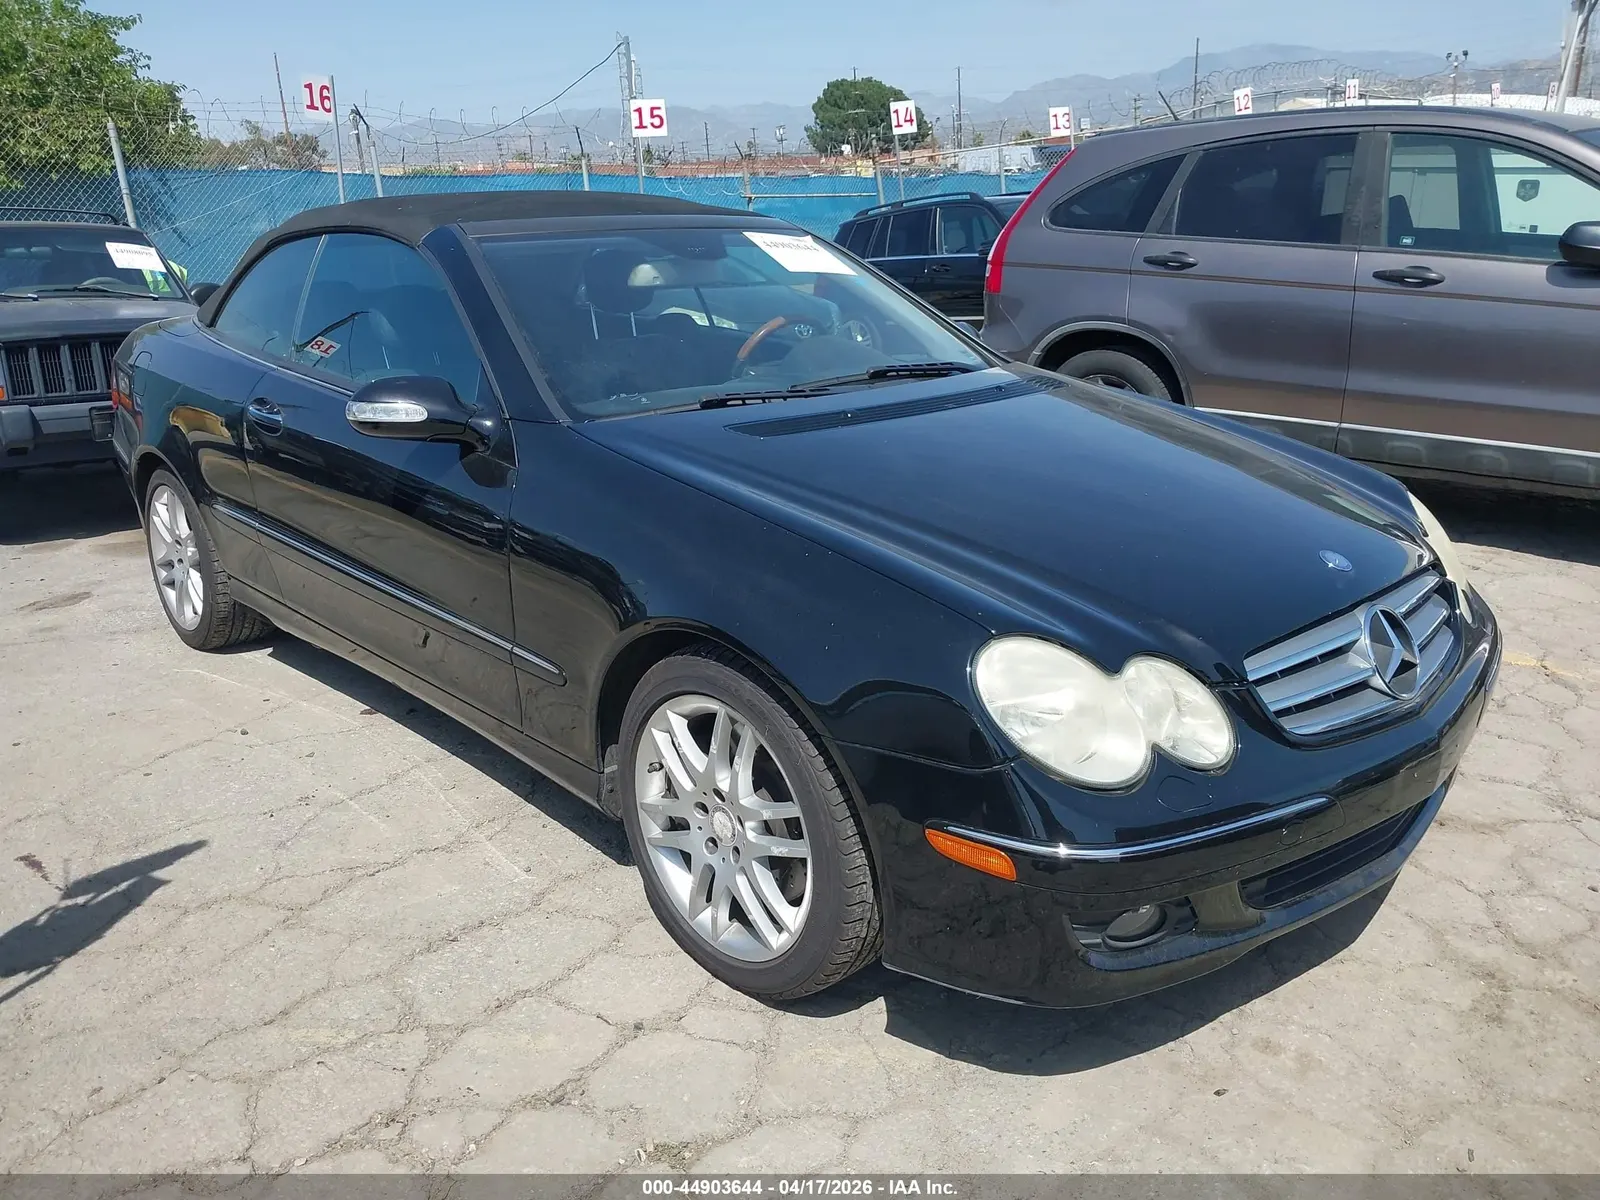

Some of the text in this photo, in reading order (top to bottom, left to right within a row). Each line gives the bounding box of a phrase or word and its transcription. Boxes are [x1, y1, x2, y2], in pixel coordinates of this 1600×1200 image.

[303, 82, 332, 113] 16
[1346, 84, 1357, 100] 11
[1235, 93, 1251, 112] 12
[632, 106, 665, 130] 15
[892, 106, 915, 128] 14
[1051, 112, 1071, 130] 13
